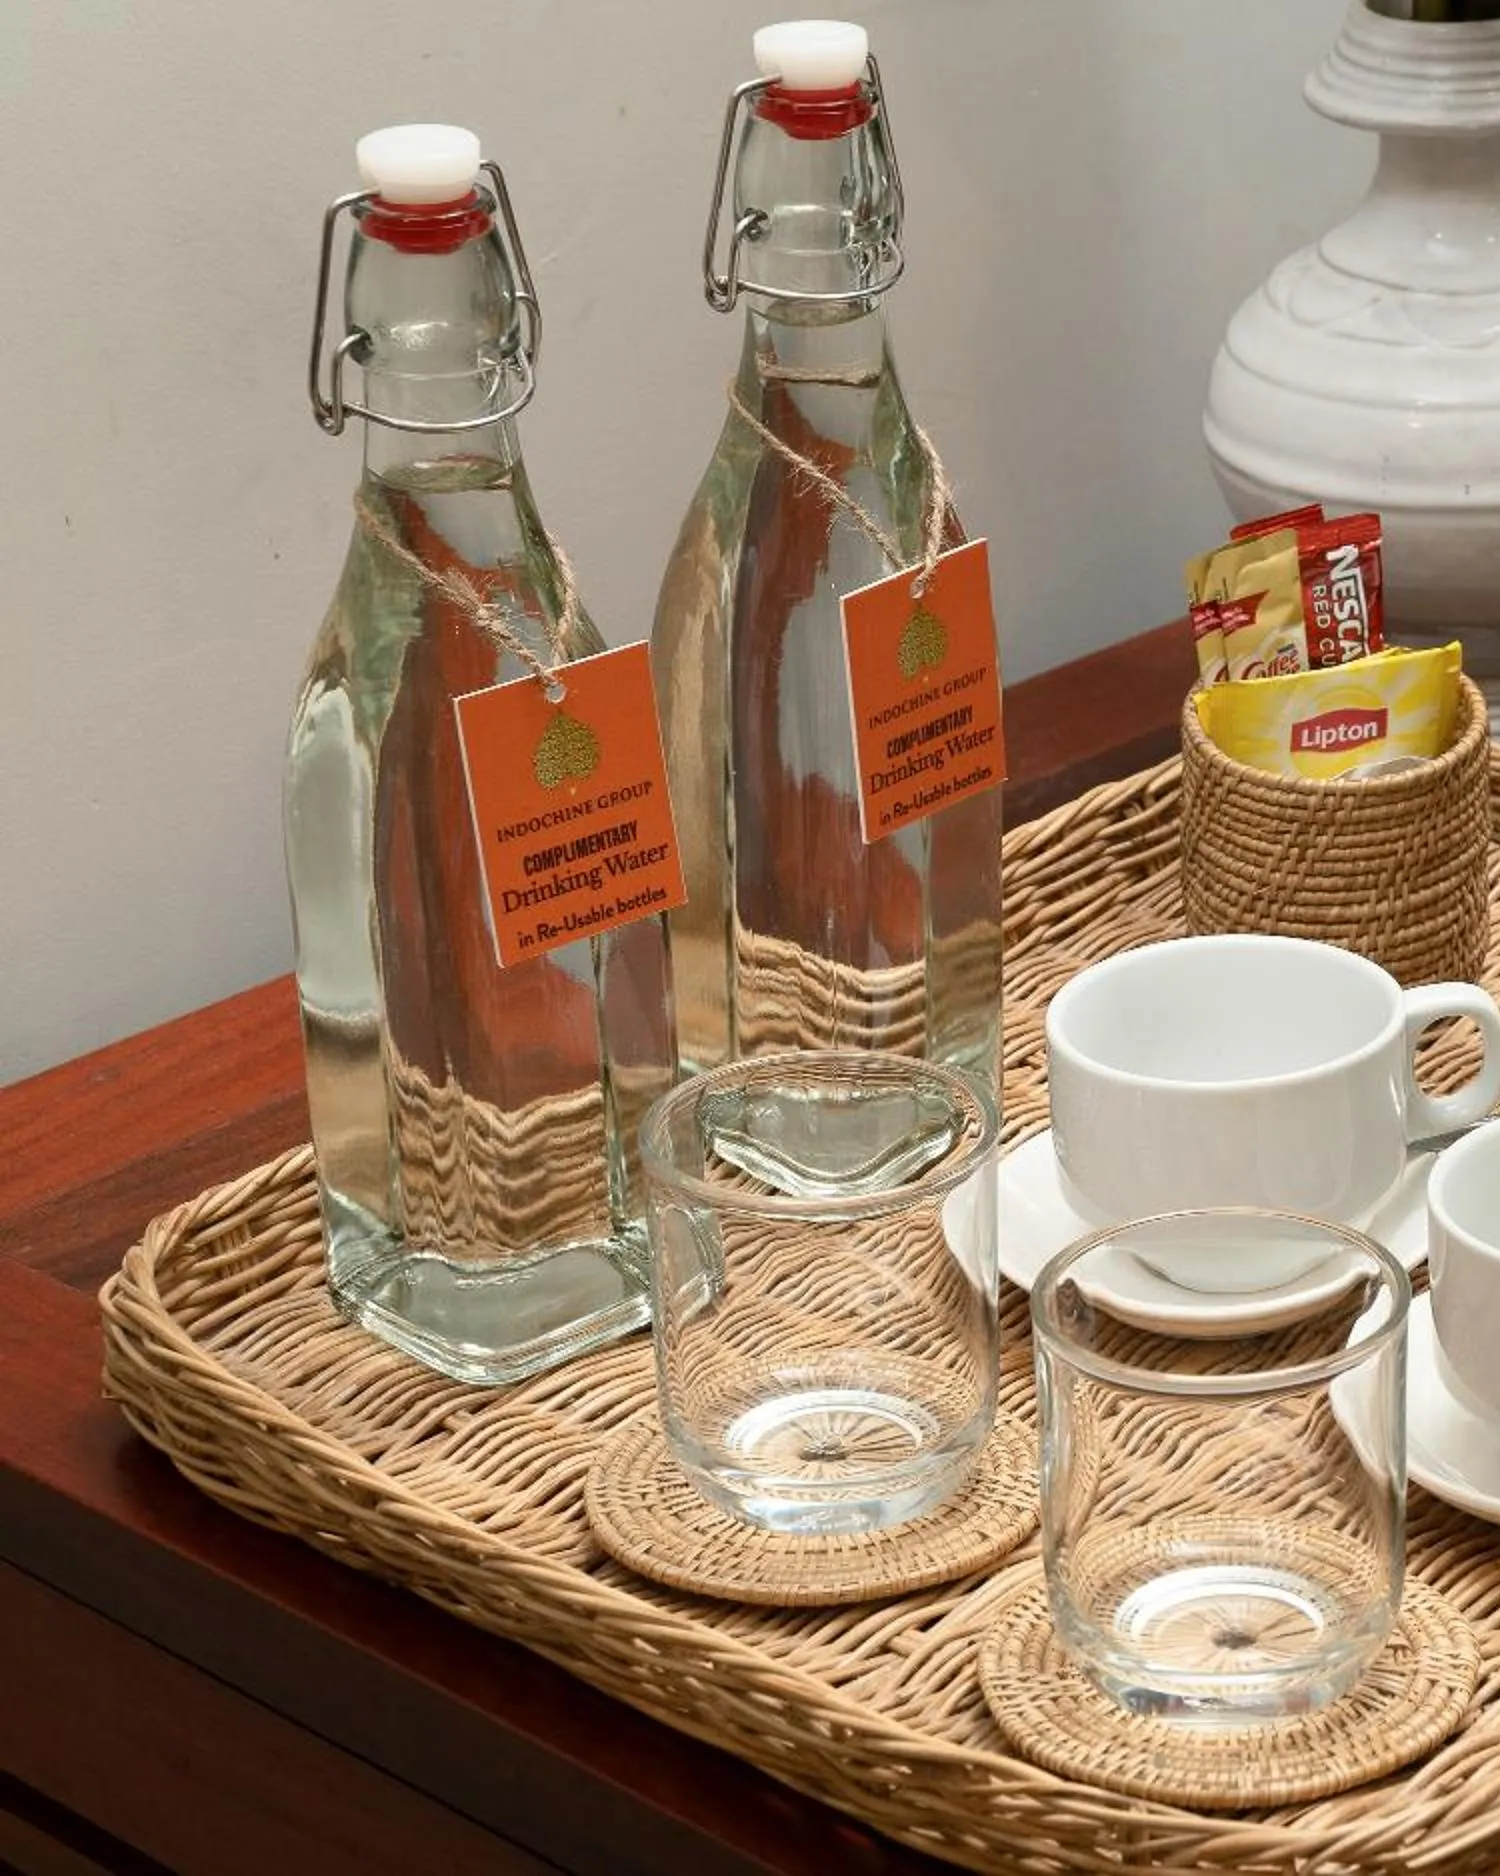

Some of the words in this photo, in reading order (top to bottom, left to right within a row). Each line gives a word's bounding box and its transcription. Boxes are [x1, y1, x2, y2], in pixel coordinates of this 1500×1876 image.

[1312, 584, 1331, 628] RED
[1326, 544, 1369, 662] NESCA
[1320, 638, 1337, 666] CU
[868, 685, 941, 729] INDOCHINE
[943, 667, 987, 696] GROUP
[869, 748, 945, 795] Drinking
[944, 726, 995, 759] Water
[886, 705, 974, 759] COMPLIMENTARY
[1300, 720, 1378, 749] Lipton
[496, 799, 592, 843] INDOCHINE
[597, 781, 653, 810] GROUP
[879, 810, 891, 825] in
[893, 777, 952, 818] Re-Usable
[953, 765, 993, 793] bottles
[502, 867, 603, 914] Drinking
[603, 843, 669, 878] Water
[523, 820, 638, 877] COMPLIMENTARY
[517, 930, 534, 949] in
[536, 902, 614, 942] Re-Usable
[617, 886, 667, 913] bottles
